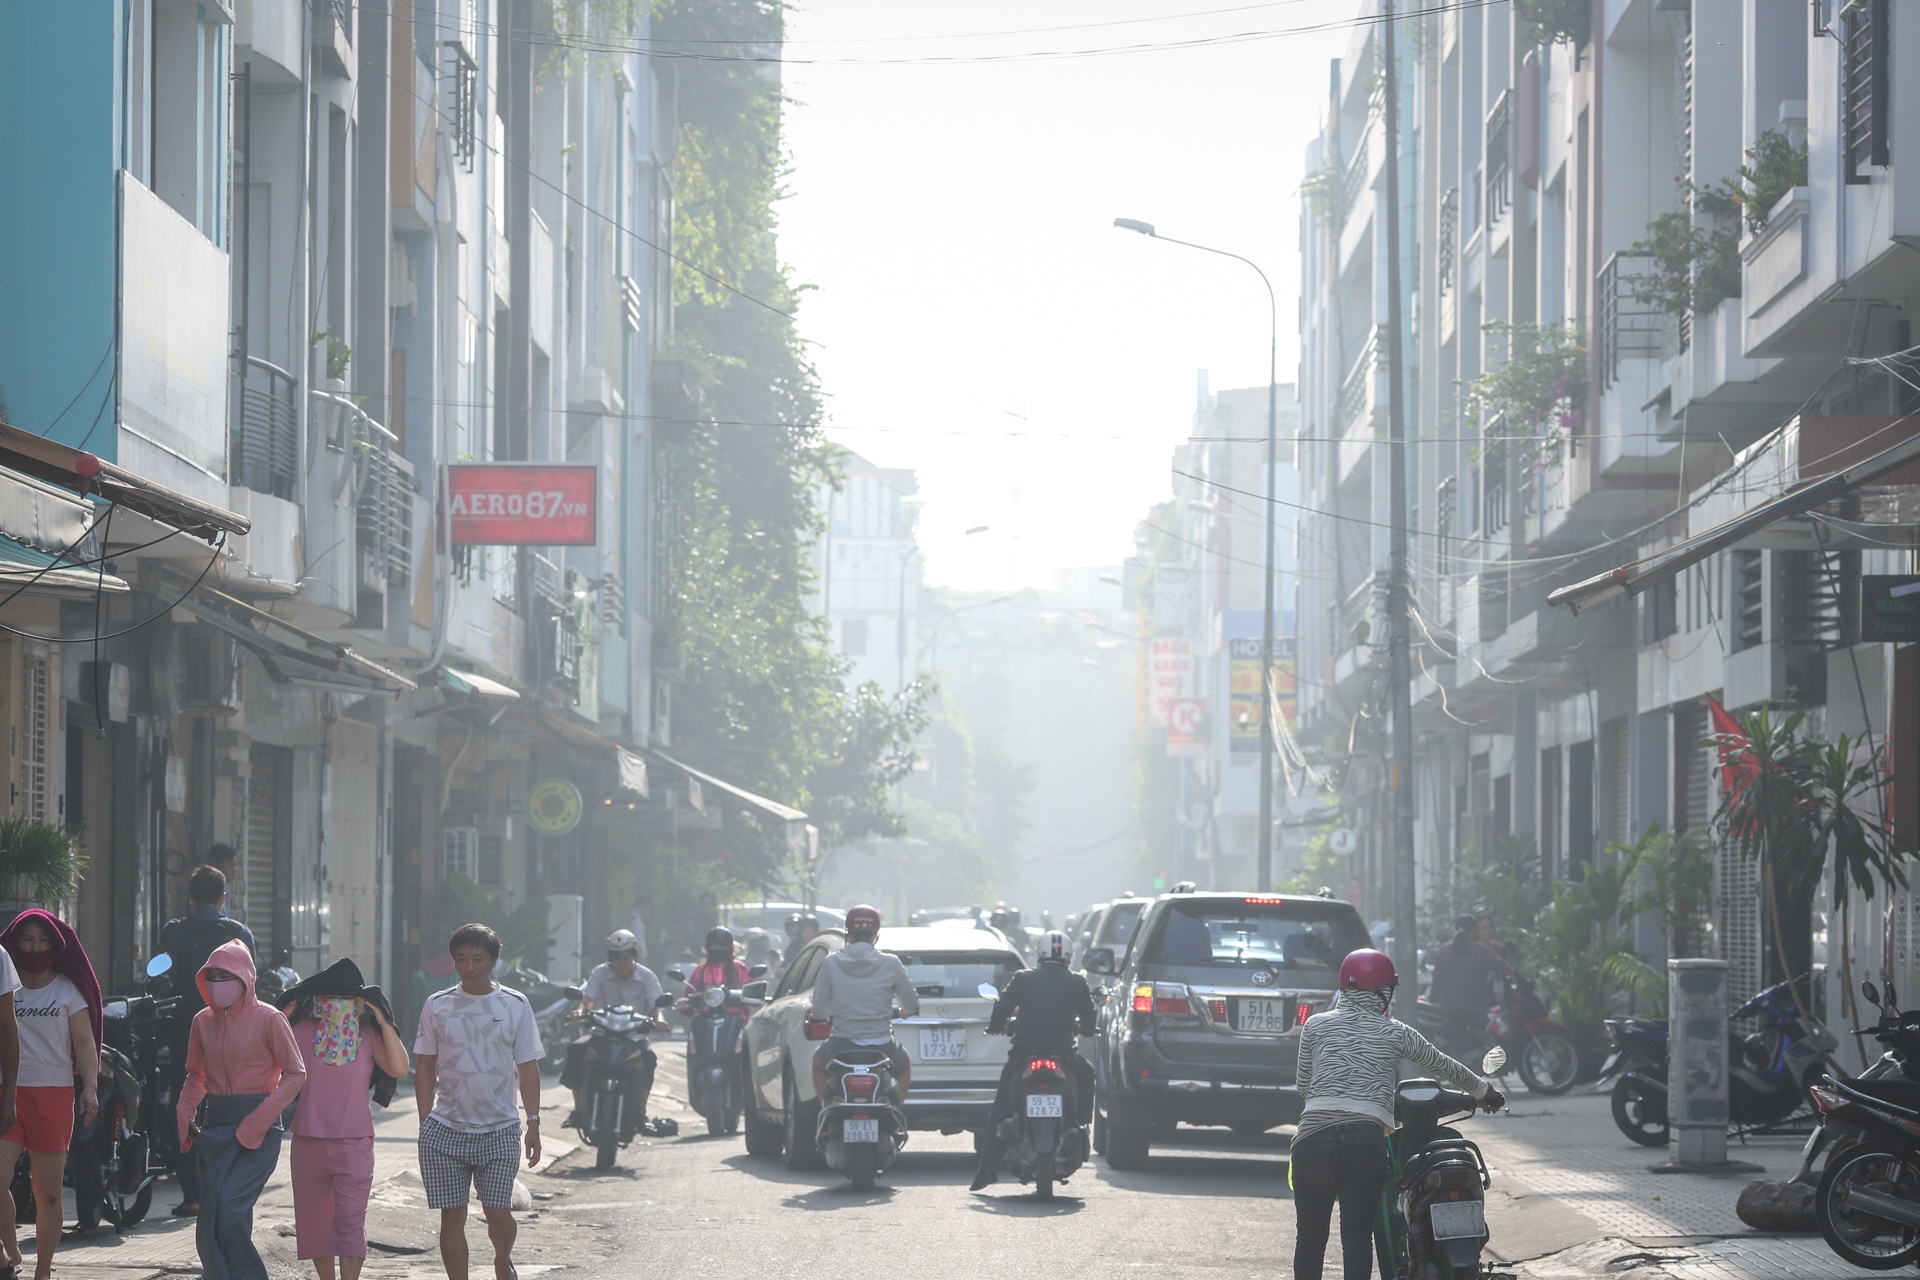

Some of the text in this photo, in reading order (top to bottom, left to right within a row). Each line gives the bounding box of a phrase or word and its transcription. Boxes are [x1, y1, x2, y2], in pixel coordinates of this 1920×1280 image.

[1231, 641, 1293, 657] HOEL
[1337, 832, 1347, 848] J
[1249, 1001, 1273, 1015] 51A
[931, 1029, 955, 1043] 51F
[924, 1043, 964, 1057] 173.47
